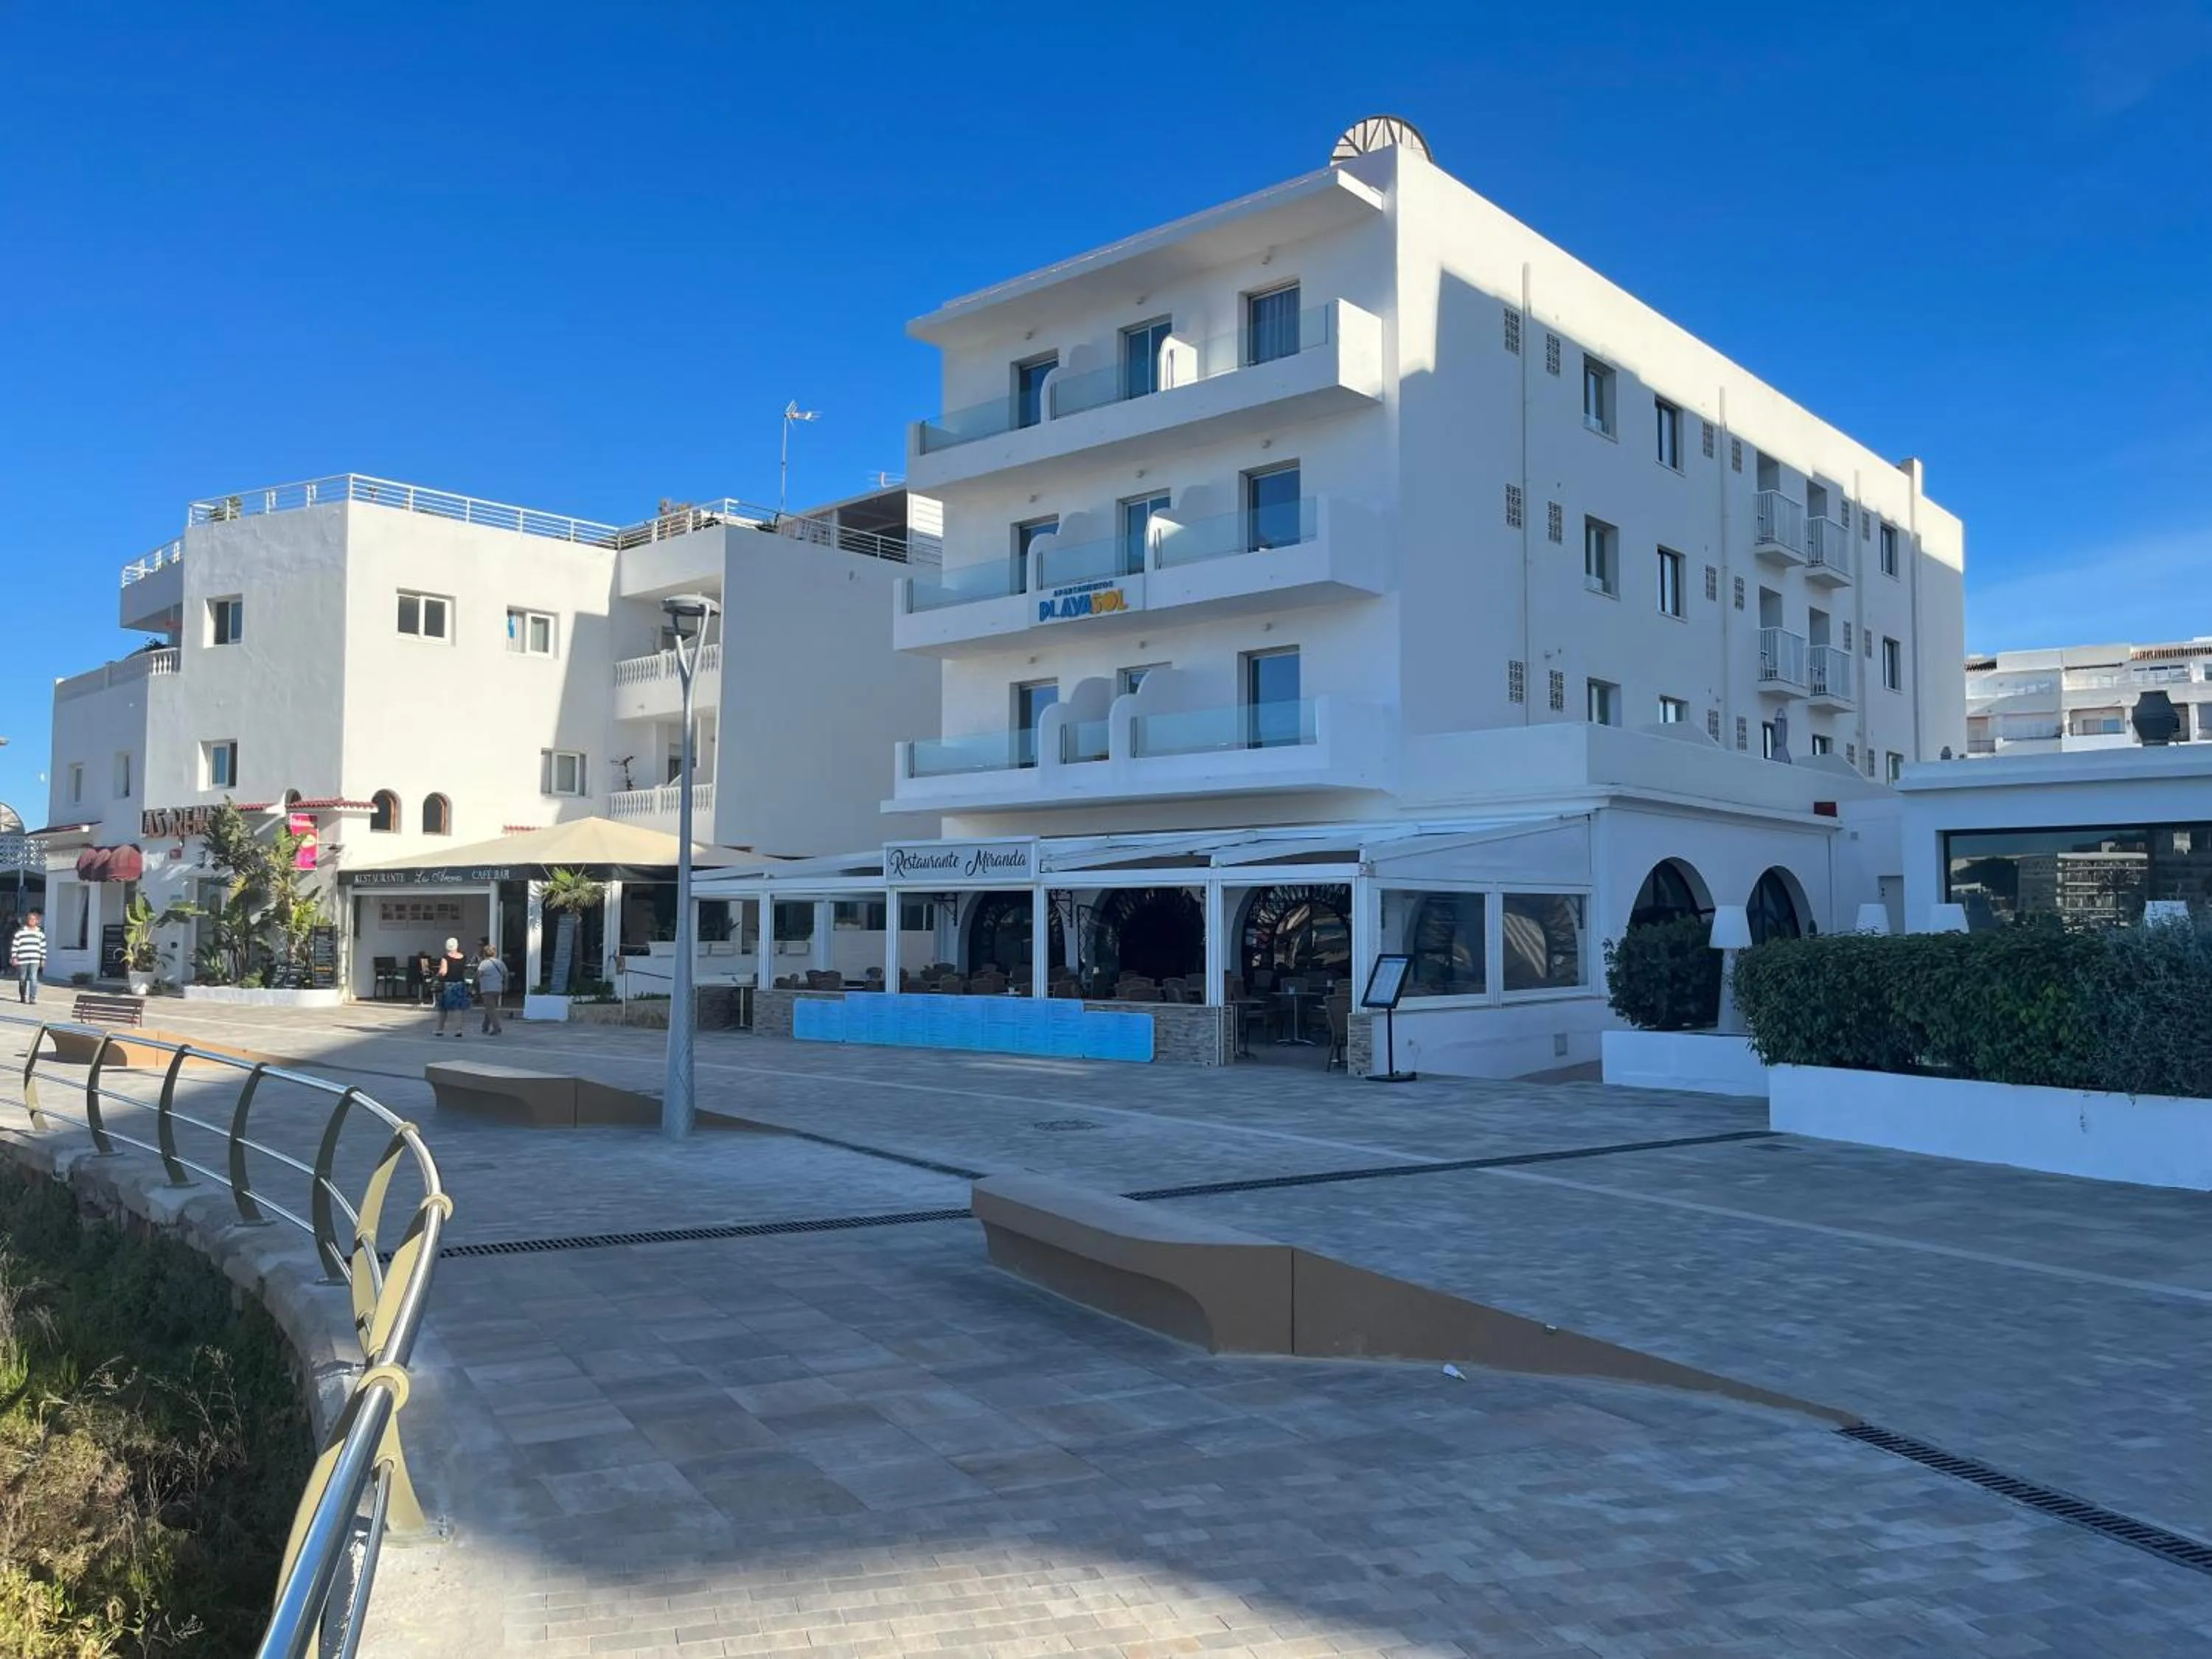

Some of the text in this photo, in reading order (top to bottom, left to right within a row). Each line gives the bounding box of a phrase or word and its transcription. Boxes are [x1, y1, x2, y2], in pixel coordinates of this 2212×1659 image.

[890, 849, 1026, 878] Restaurante Miranda
[354, 872, 405, 883] RESTAURANTE
